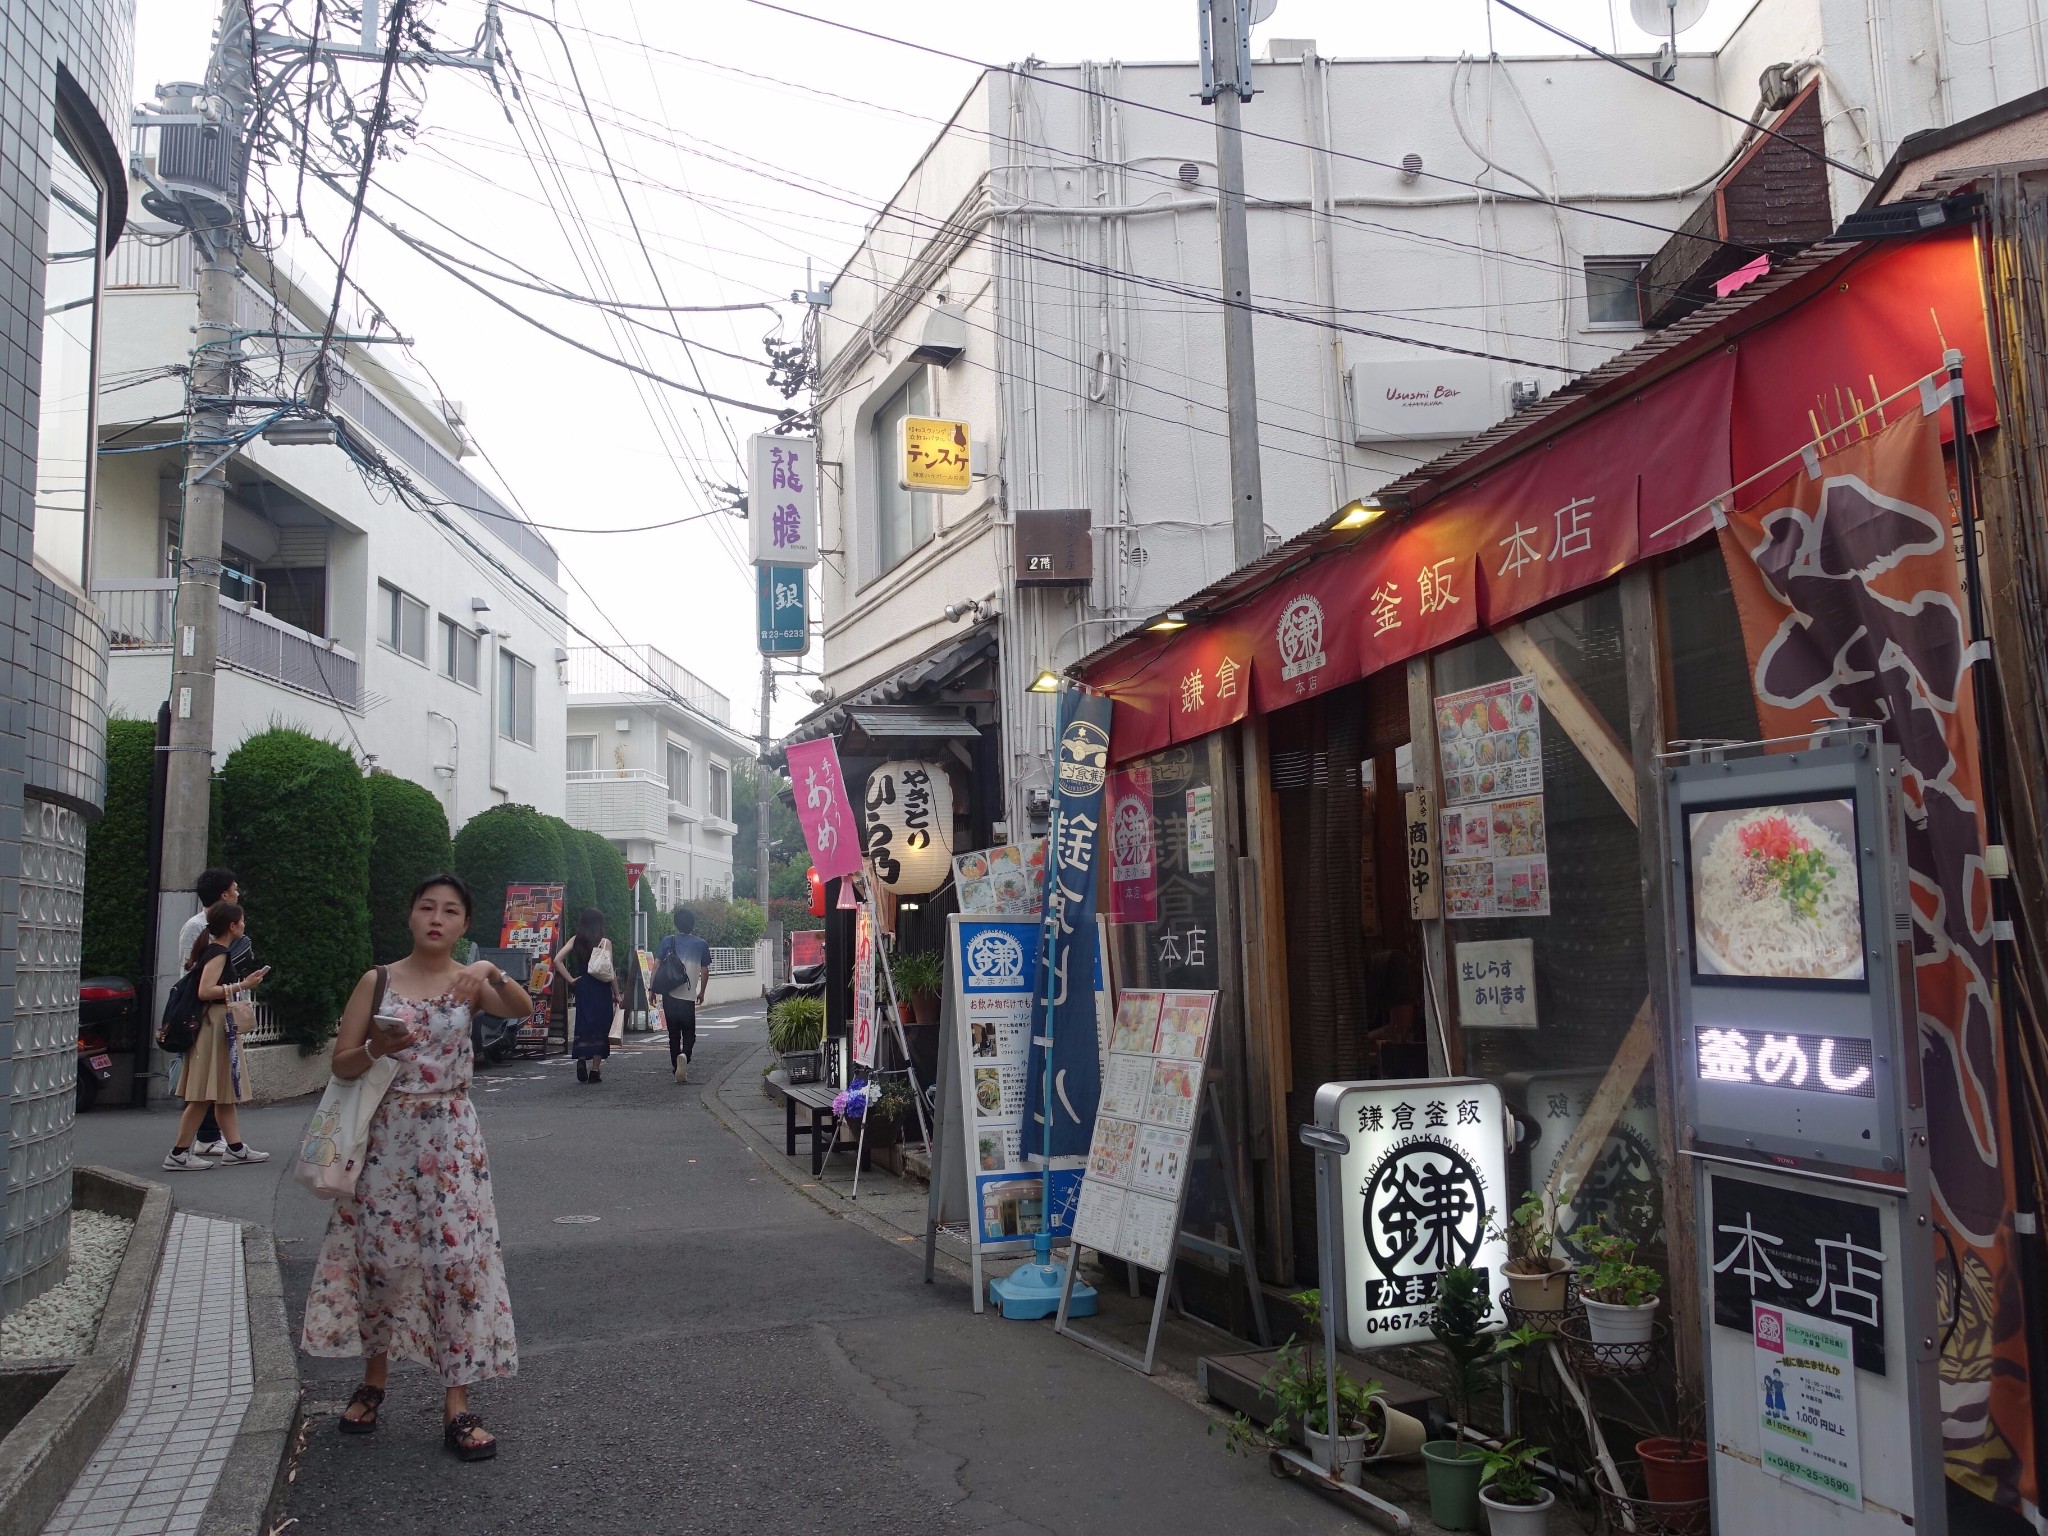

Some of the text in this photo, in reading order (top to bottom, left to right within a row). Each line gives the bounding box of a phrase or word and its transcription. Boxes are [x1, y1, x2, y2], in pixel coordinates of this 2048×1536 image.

[1433, 385, 1462, 399] Bar
[907, 444, 969, 472] テンスケ
[1029, 556, 1052, 570] 2階
[775, 582, 804, 610] 銀
[1180, 496, 1596, 714] 鎌倉 釜飯 本店
[768, 629, 804, 639] 23-6233
[1286, 655, 1322, 677] かまかま
[1295, 675, 1317, 695] 本店
[804, 766, 838, 862] あめ
[901, 769, 931, 849] やきとり
[1408, 821, 1430, 894] 商い中
[1115, 865, 1147, 880] かまかま
[1158, 924, 1207, 968] 本店
[1462, 959, 1512, 981] 生しらす
[974, 977, 1019, 986] かまかま
[970, 998, 1034, 1010] お飲み物だけでも
[1475, 985, 1527, 1006] あります
[1013, 1013, 1032, 1021] ドリン
[1698, 1027, 1872, 1093] 釜めし
[1357, 1098, 1482, 1133] 鎌倉釜飯
[1713, 1211, 1888, 1327] 本店
[1775, 1356, 1841, 1376] 一緒に働きませんか
[1796, 1411, 1846, 1438] 1,000 円以上
